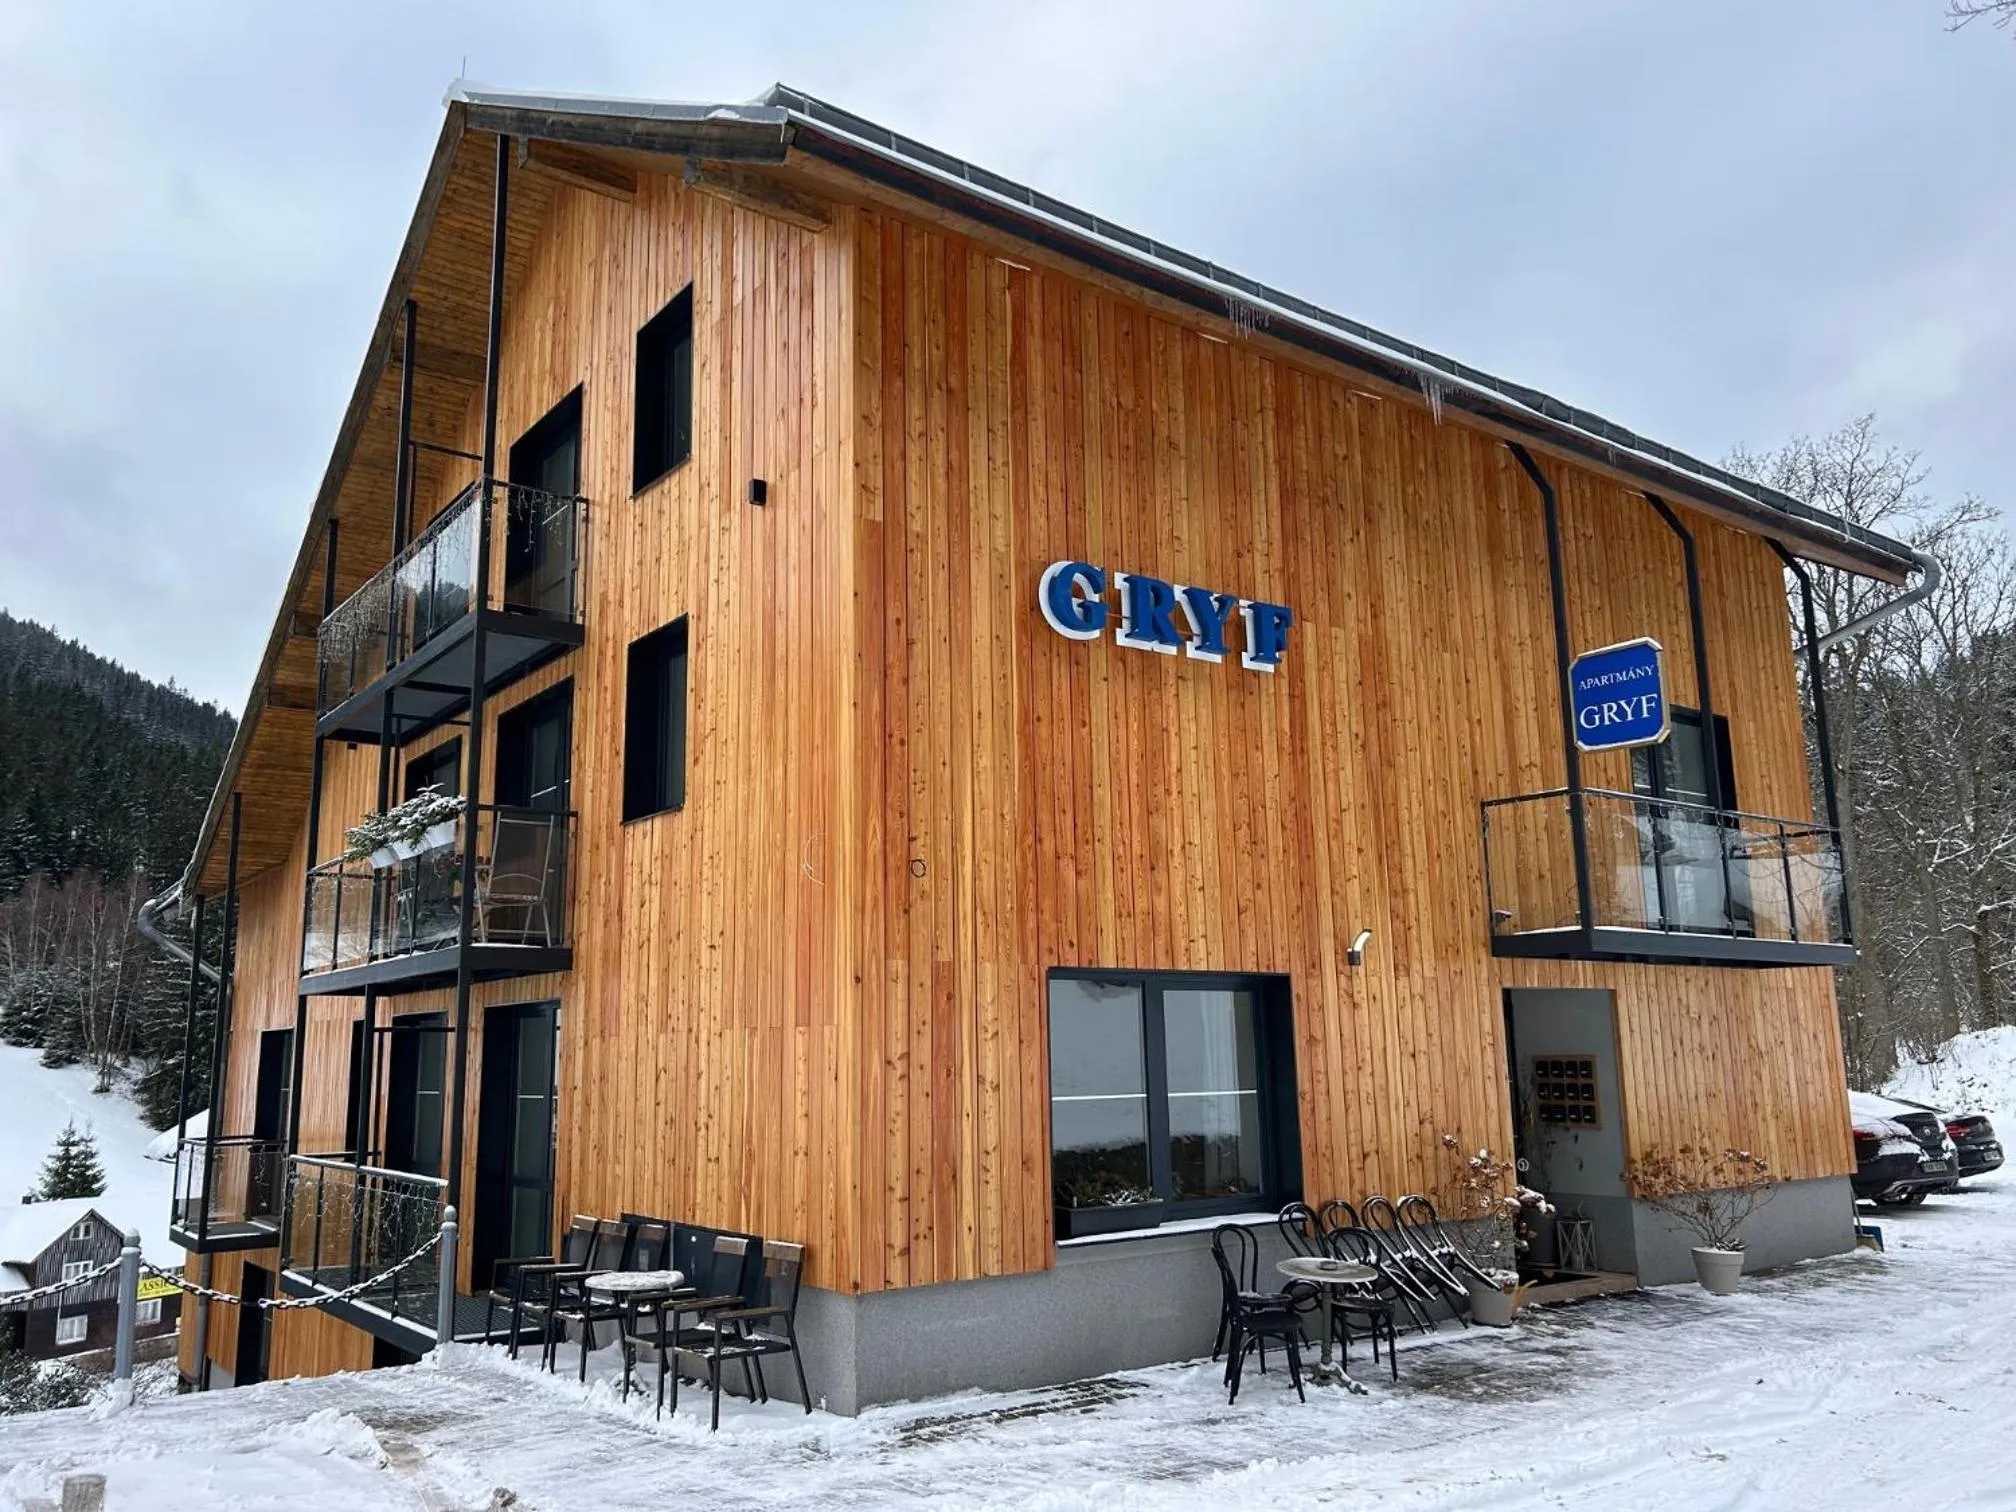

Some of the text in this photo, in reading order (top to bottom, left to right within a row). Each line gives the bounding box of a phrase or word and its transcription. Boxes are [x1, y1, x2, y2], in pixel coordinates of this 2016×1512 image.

[1039, 560, 1293, 673] GRYF
[1579, 665, 1655, 691] APARTMÁNY
[1580, 693, 1658, 729] GRYF
